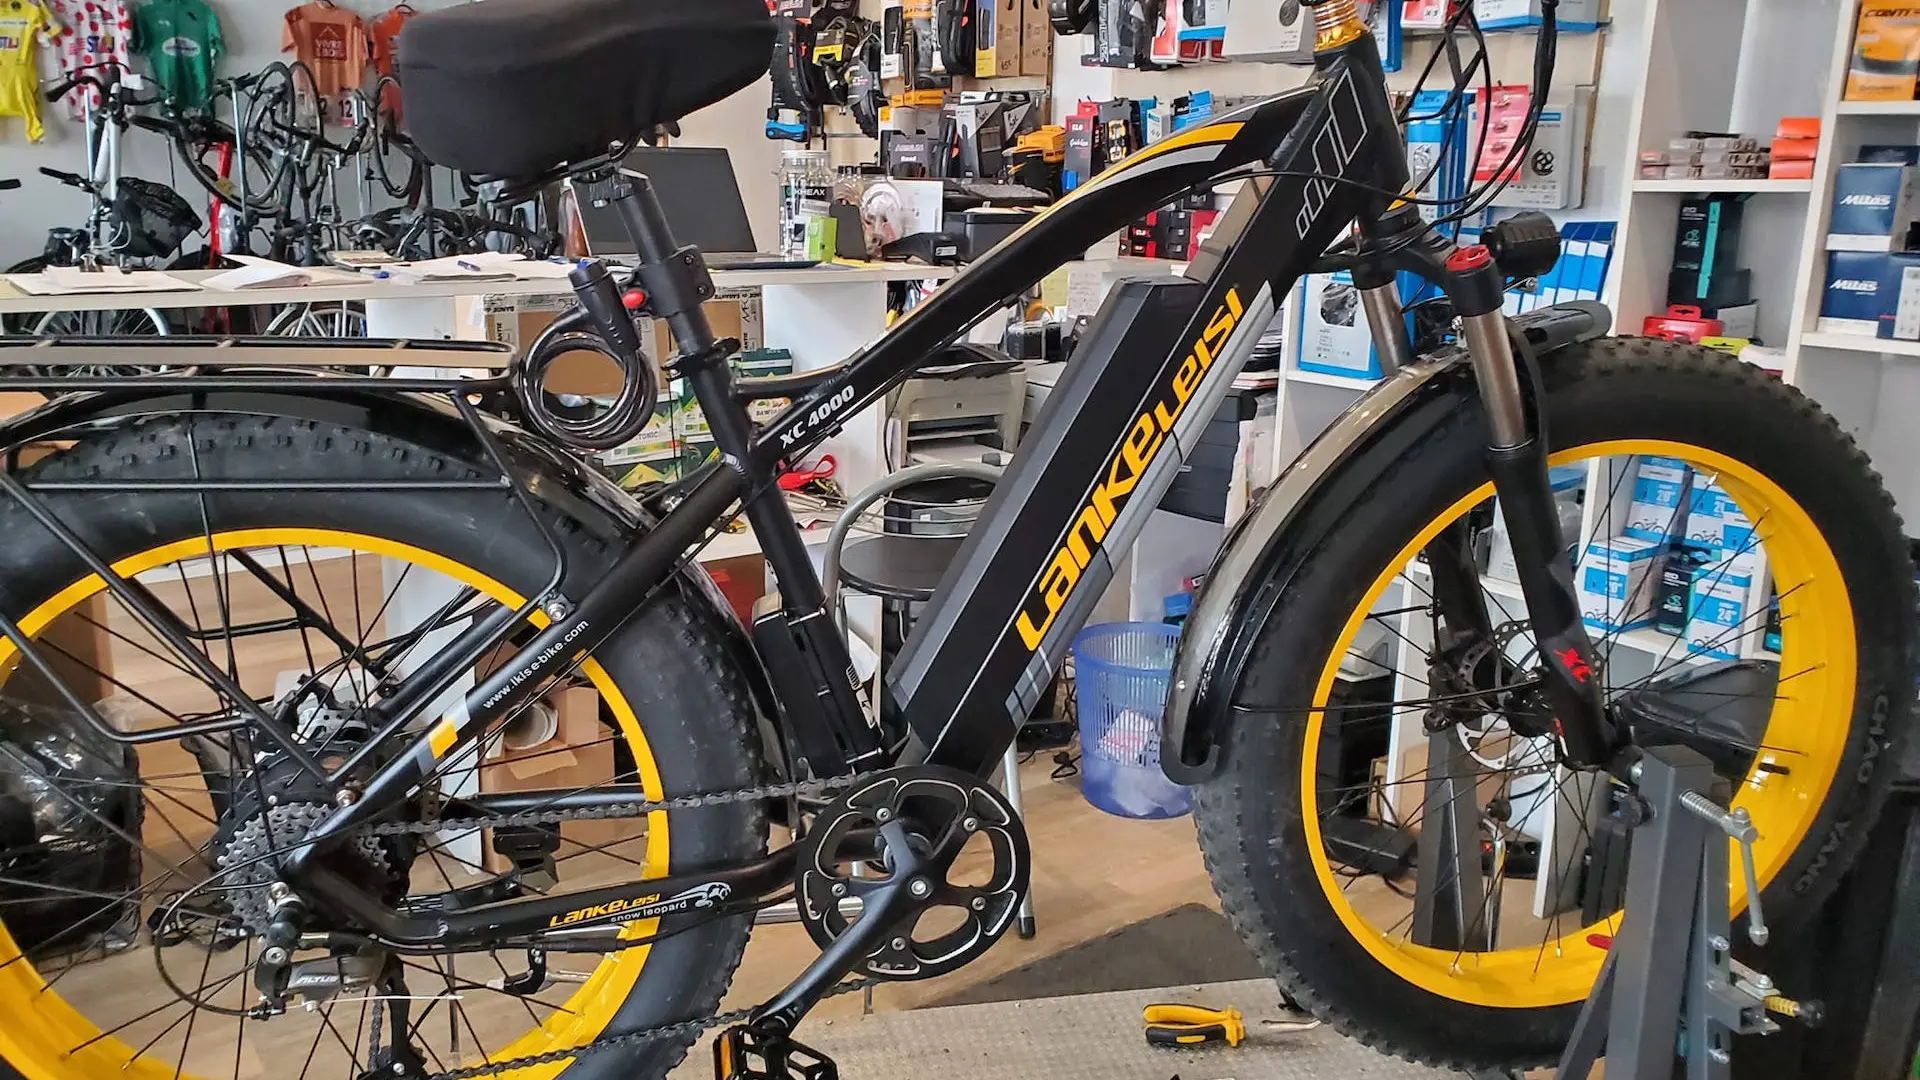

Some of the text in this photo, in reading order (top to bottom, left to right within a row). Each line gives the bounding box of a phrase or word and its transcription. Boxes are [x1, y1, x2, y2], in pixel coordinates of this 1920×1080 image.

[338, 100, 353, 118] 12
[638, 431, 659, 441] TONIC
[779, 384, 856, 451] XC 4000
[482, 619, 590, 710] www.lkise-bike.com
[1857, 694, 1889, 784] CHAO
[1792, 819, 1851, 894] YANG
[610, 899, 688, 923] snow leopard
[295, 974, 340, 985] ALTUS
